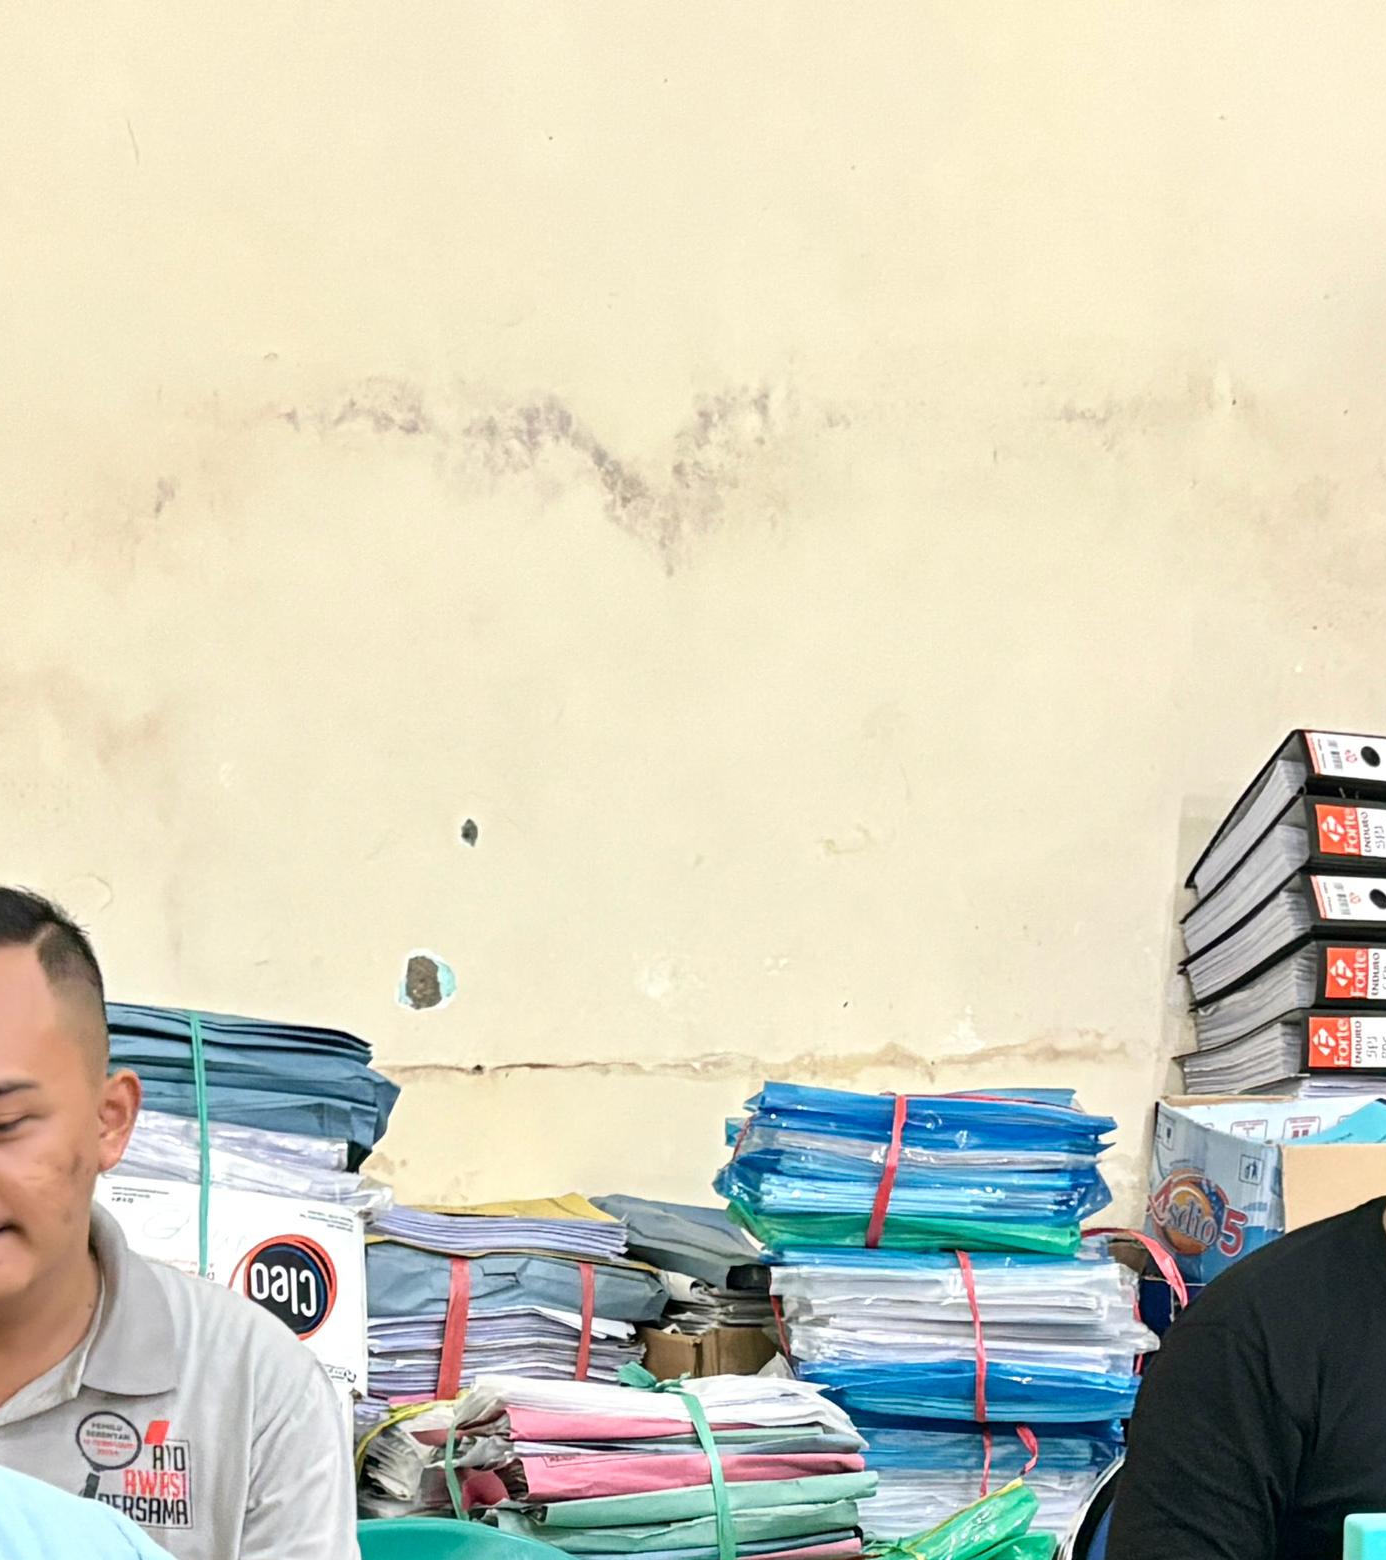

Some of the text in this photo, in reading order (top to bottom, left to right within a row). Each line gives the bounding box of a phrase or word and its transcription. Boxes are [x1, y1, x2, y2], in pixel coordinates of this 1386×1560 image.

[1343, 807, 1360, 855] Forte
[1361, 811, 1372, 853] ENDURO
[1350, 948, 1367, 998] Forte
[1371, 952, 1380, 996] ENDURO
[1334, 1019, 1351, 1066] Forte
[1354, 1020, 1362, 1064] ENDURO
[1217, 1206, 1249, 1257] 5
[250, 1262, 317, 1318] Cleo
[124, 1468, 188, 1499] AWASI
